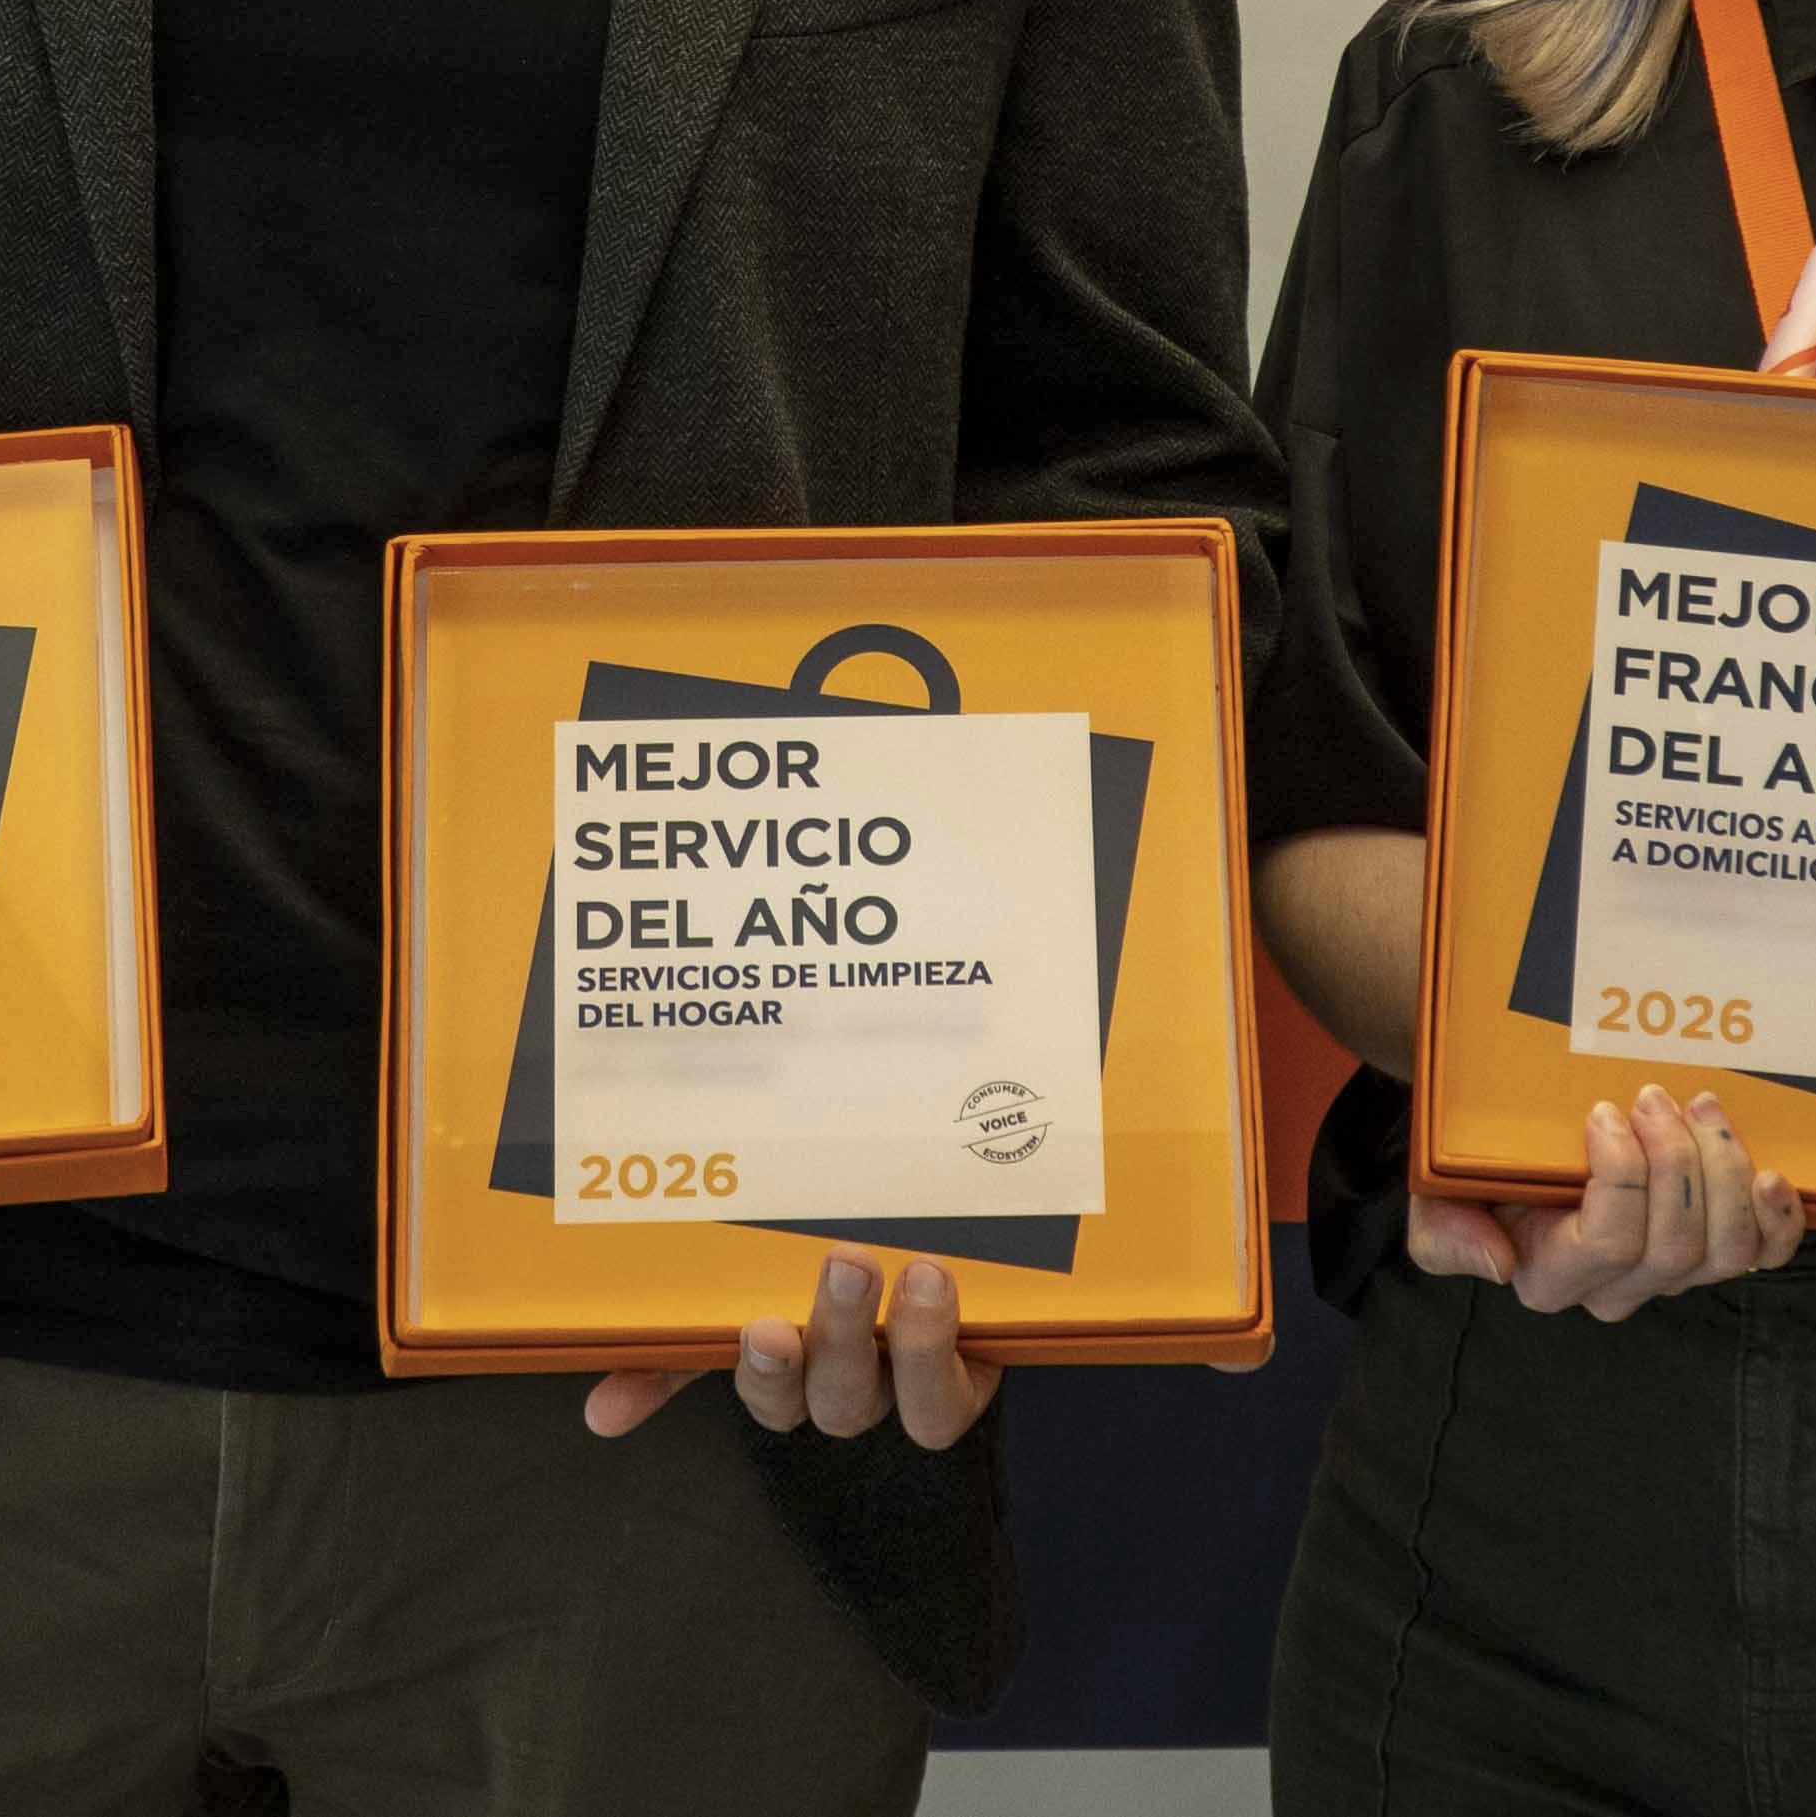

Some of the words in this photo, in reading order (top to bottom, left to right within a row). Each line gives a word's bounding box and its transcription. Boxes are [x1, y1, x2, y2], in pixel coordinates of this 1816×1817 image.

[576, 741, 820, 792] MEJOR
[1609, 726, 1743, 786] DEL
[1615, 800, 1783, 841] SERVICIOS
[574, 817, 911, 870] SERVICIO
[1612, 838, 1637, 864] A
[577, 900, 713, 950] DEL
[735, 883, 898, 947] AÑO
[578, 965, 760, 992] SERVICIOS
[773, 964, 817, 988] DE
[830, 961, 992, 987] LIMPIEZA
[579, 1003, 643, 1028] DEL
[653, 1001, 782, 1026] HOGAR
[1597, 987, 1753, 1044] 2026
[967, 1085, 1025, 1110] CONSUMER
[979, 1111, 1028, 1133] VOICE
[578, 1153, 738, 1199] 2026
